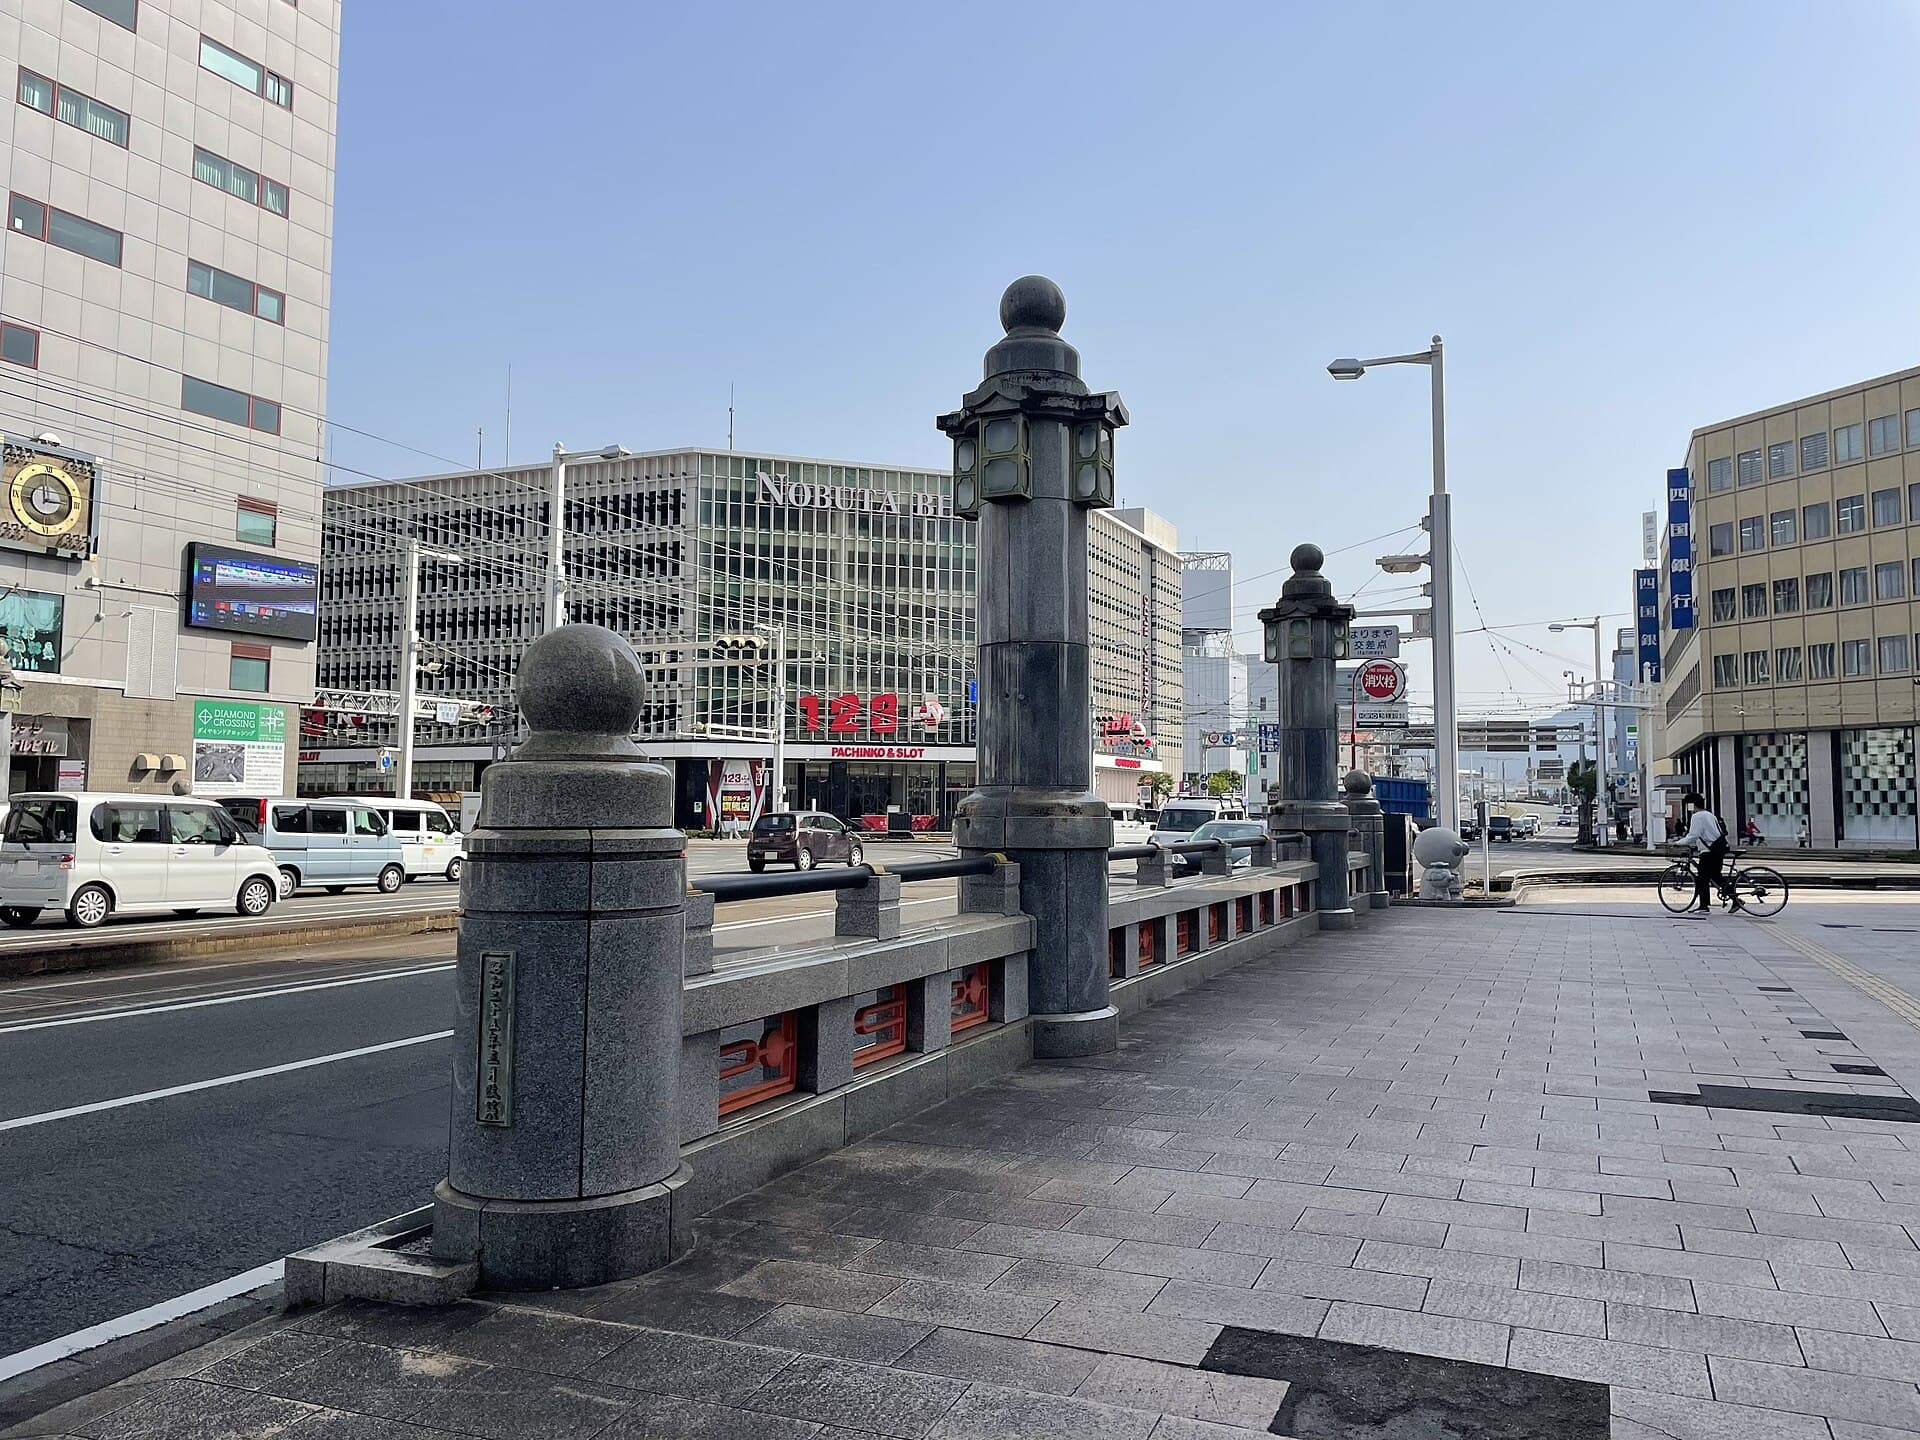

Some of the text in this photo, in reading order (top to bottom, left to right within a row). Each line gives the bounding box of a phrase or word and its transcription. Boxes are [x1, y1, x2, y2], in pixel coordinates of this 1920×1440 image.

[755, 471, 900, 514] NOBUTA
[1670, 487, 1691, 608] 四国銀行
[1354, 640, 1388, 650] 交差点
[1364, 674, 1395, 688] 消火栓
[214, 709, 256, 720] DIAMOND
[213, 718, 256, 729] CROSSING
[831, 747, 925, 758] PACHINKO & SLOT
[723, 774, 741, 783] 123
